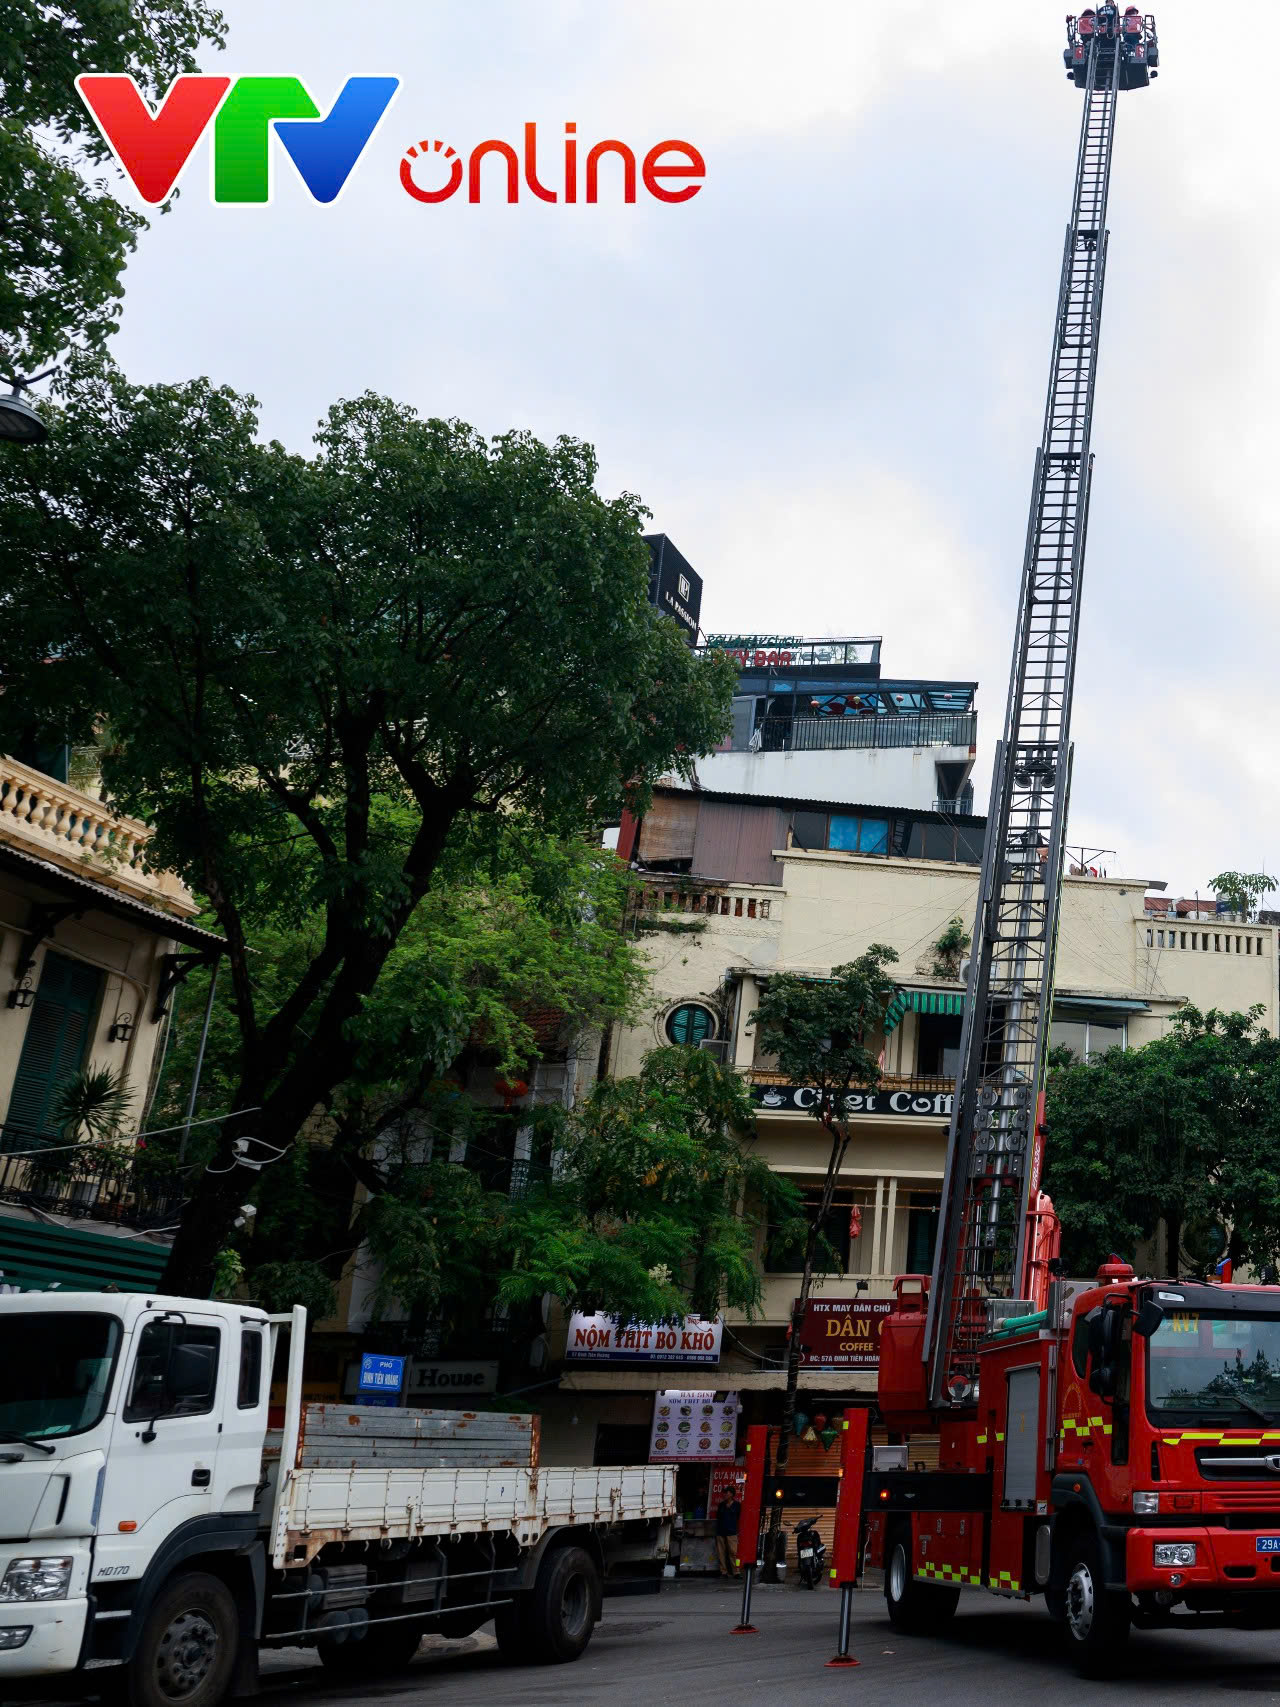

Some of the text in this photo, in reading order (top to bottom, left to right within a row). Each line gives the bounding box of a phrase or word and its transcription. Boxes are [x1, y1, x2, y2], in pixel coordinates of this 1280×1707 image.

[665, 591, 697, 631] LA PASSION
[755, 650, 792, 667] BAR
[794, 1087, 960, 1113] Ciet Coff
[814, 1304, 830, 1312] HTX
[832, 1304, 851, 1312] MAY
[873, 1302, 891, 1312] CHỦ
[826, 1314, 871, 1336] DÂN
[1172, 1312, 1199, 1332] KV7
[574, 1324, 714, 1352] NỘM THỊT BÒ KHÔ
[840, 1343, 874, 1351] COFFEE
[380, 1360, 393, 1368] PHỐ
[864, 1354, 880, 1362] HOÀN
[418, 1368, 485, 1387] House
[97, 1565, 130, 1576] HD170
